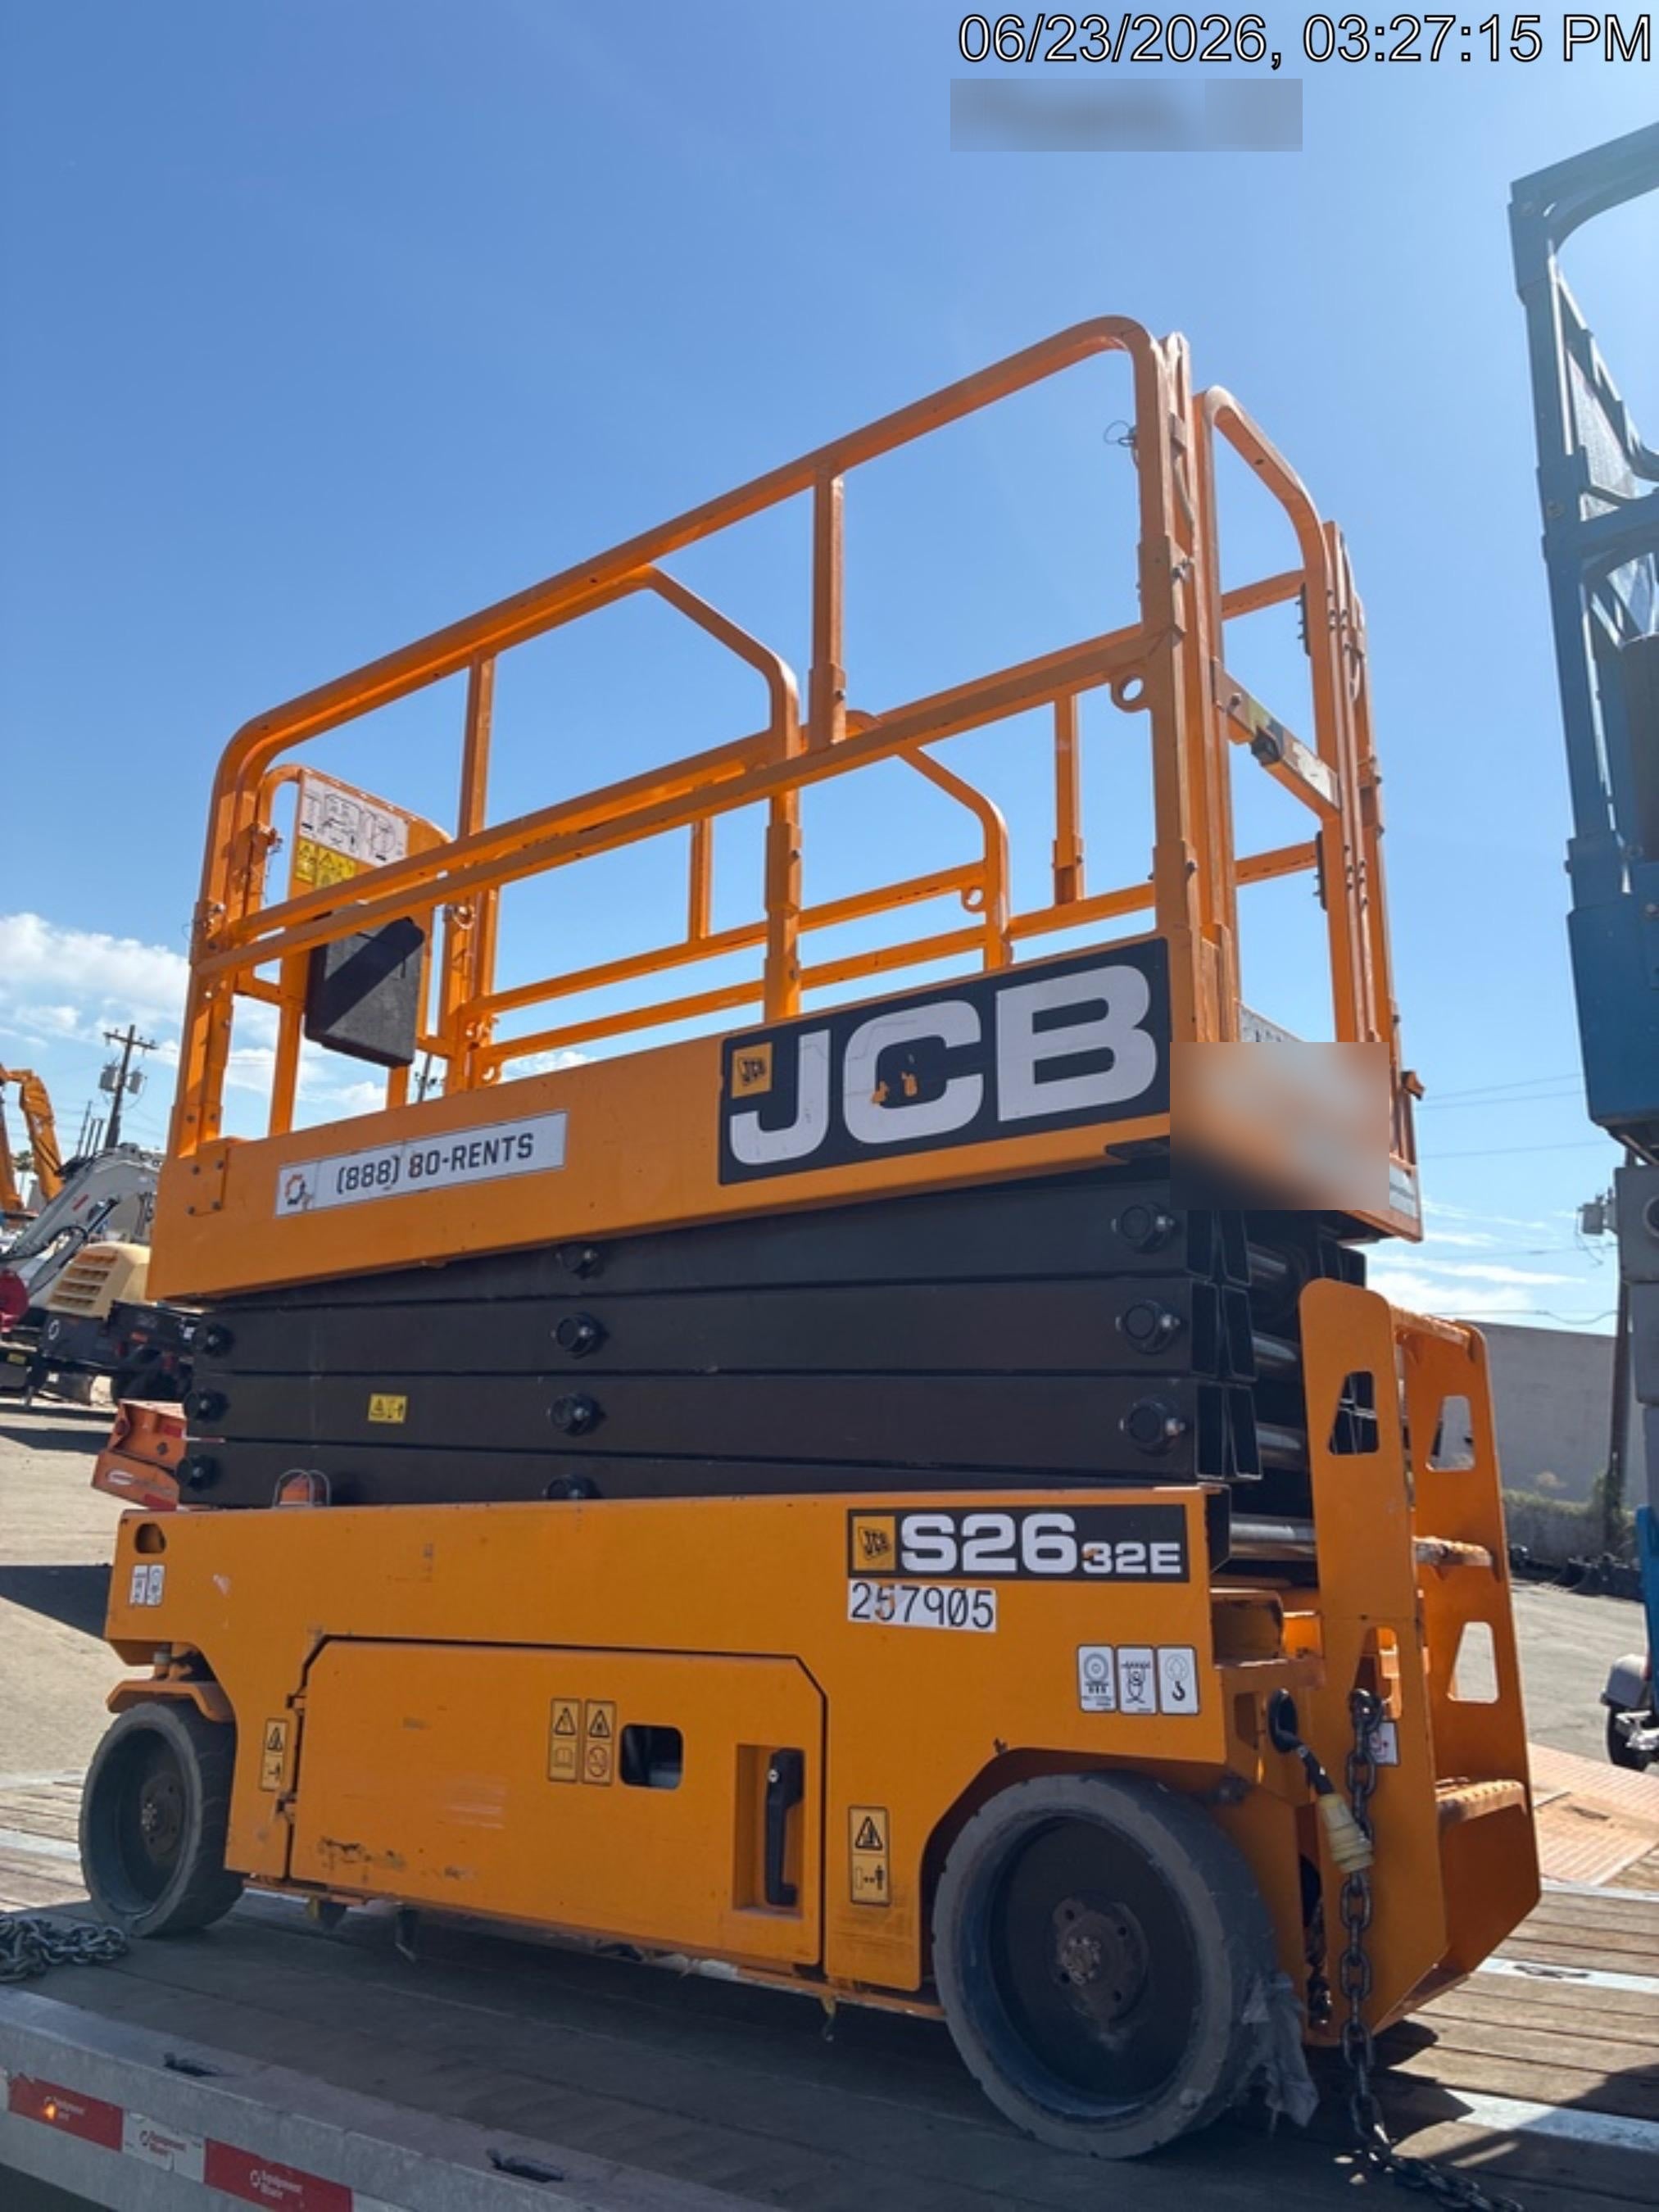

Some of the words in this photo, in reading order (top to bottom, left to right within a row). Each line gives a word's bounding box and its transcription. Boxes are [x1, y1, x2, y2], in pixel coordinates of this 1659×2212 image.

[729, 964, 1158, 1165] JCB
[336, 1154, 401, 1194] (888)
[408, 1132, 535, 1179] 80-RENTS
[851, 1582, 995, 1629] 257905
